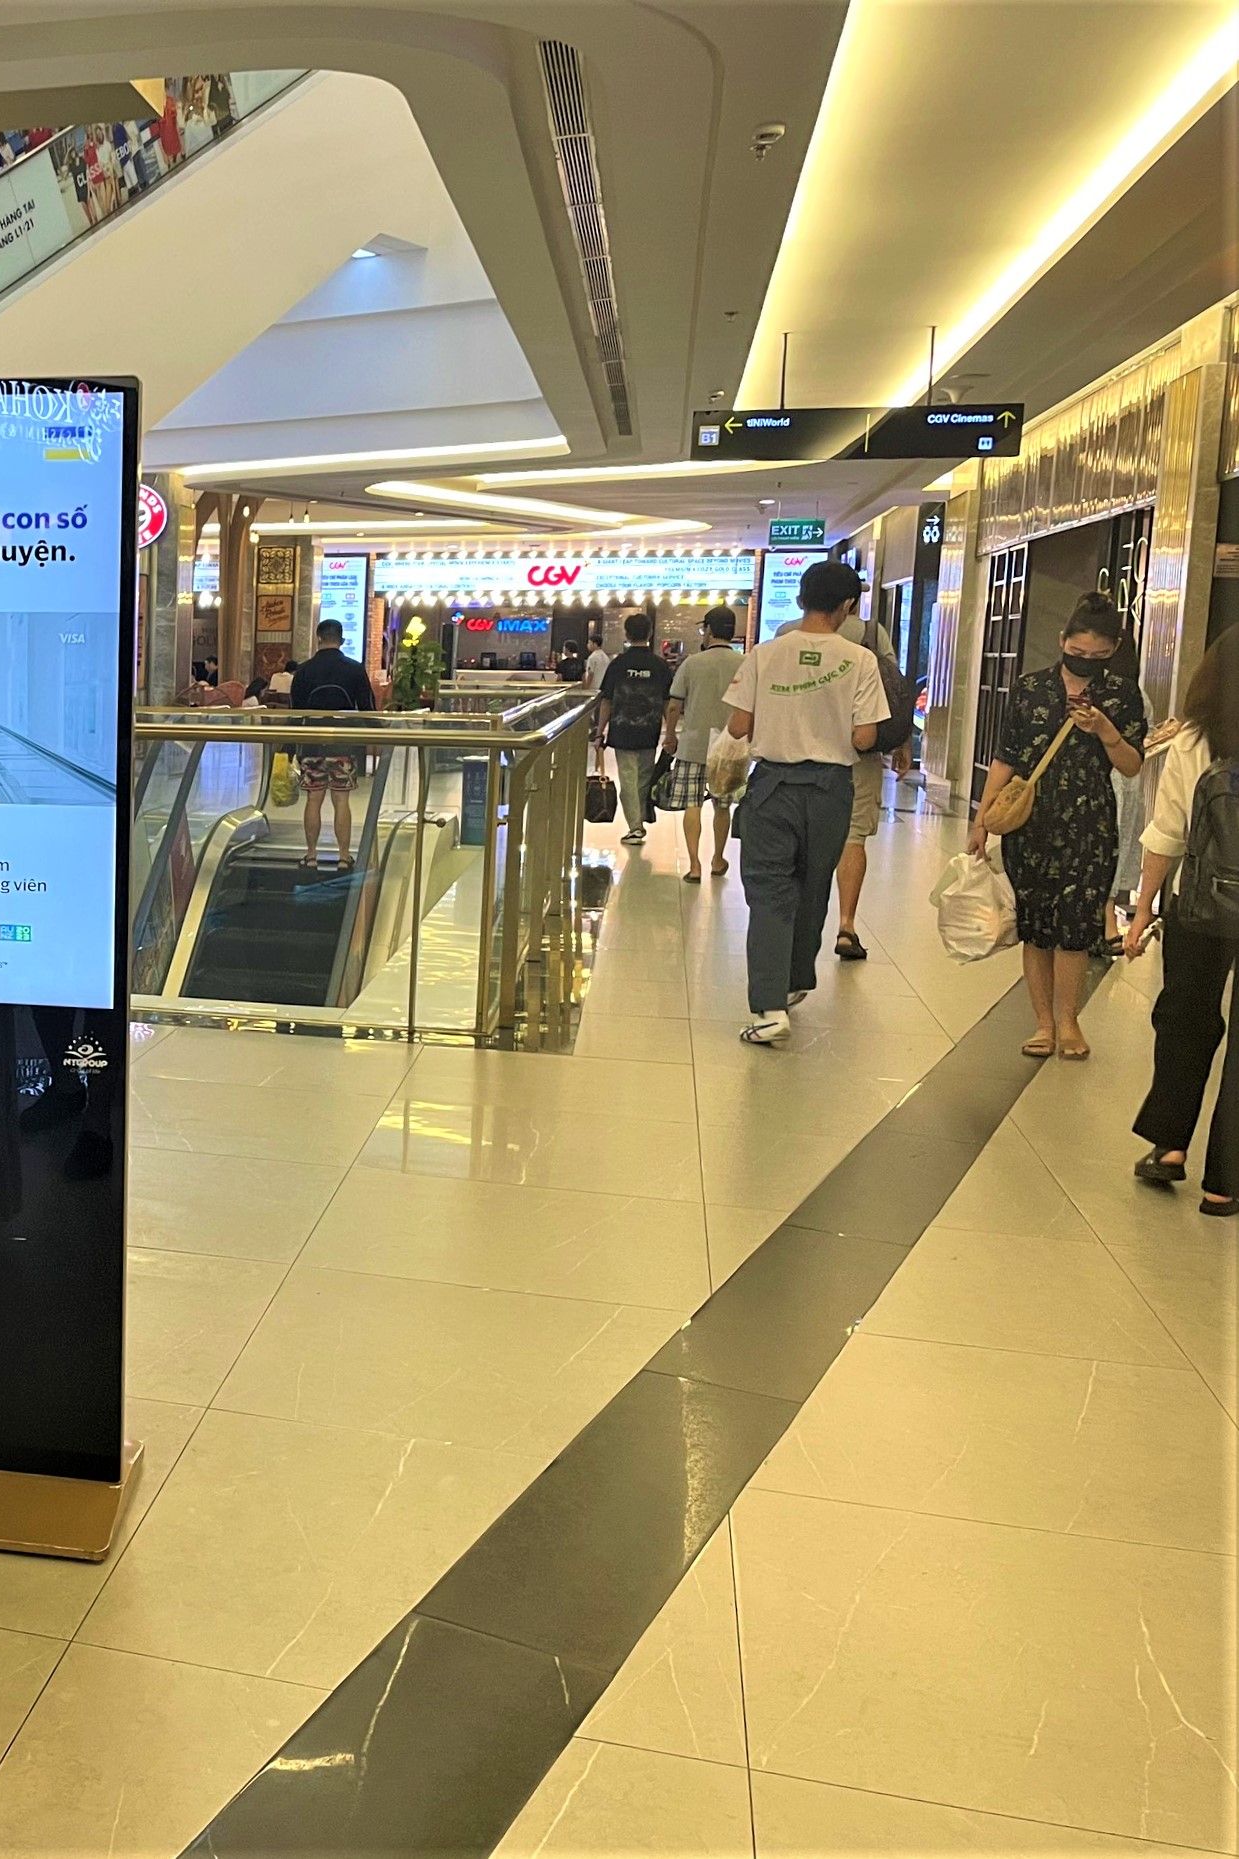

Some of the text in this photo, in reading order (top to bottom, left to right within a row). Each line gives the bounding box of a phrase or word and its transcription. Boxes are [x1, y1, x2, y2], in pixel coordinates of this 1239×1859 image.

[927, 413, 993, 424] CGV Cinemas
[701, 433, 716, 444] B1
[2, 512, 50, 530] con
[57, 504, 88, 530] số
[771, 525, 801, 536] EXIT
[528, 565, 583, 587] CGV
[466, 619, 493, 631] CGV
[59, 634, 85, 644] VISA
[14, 878, 47, 892] viên
